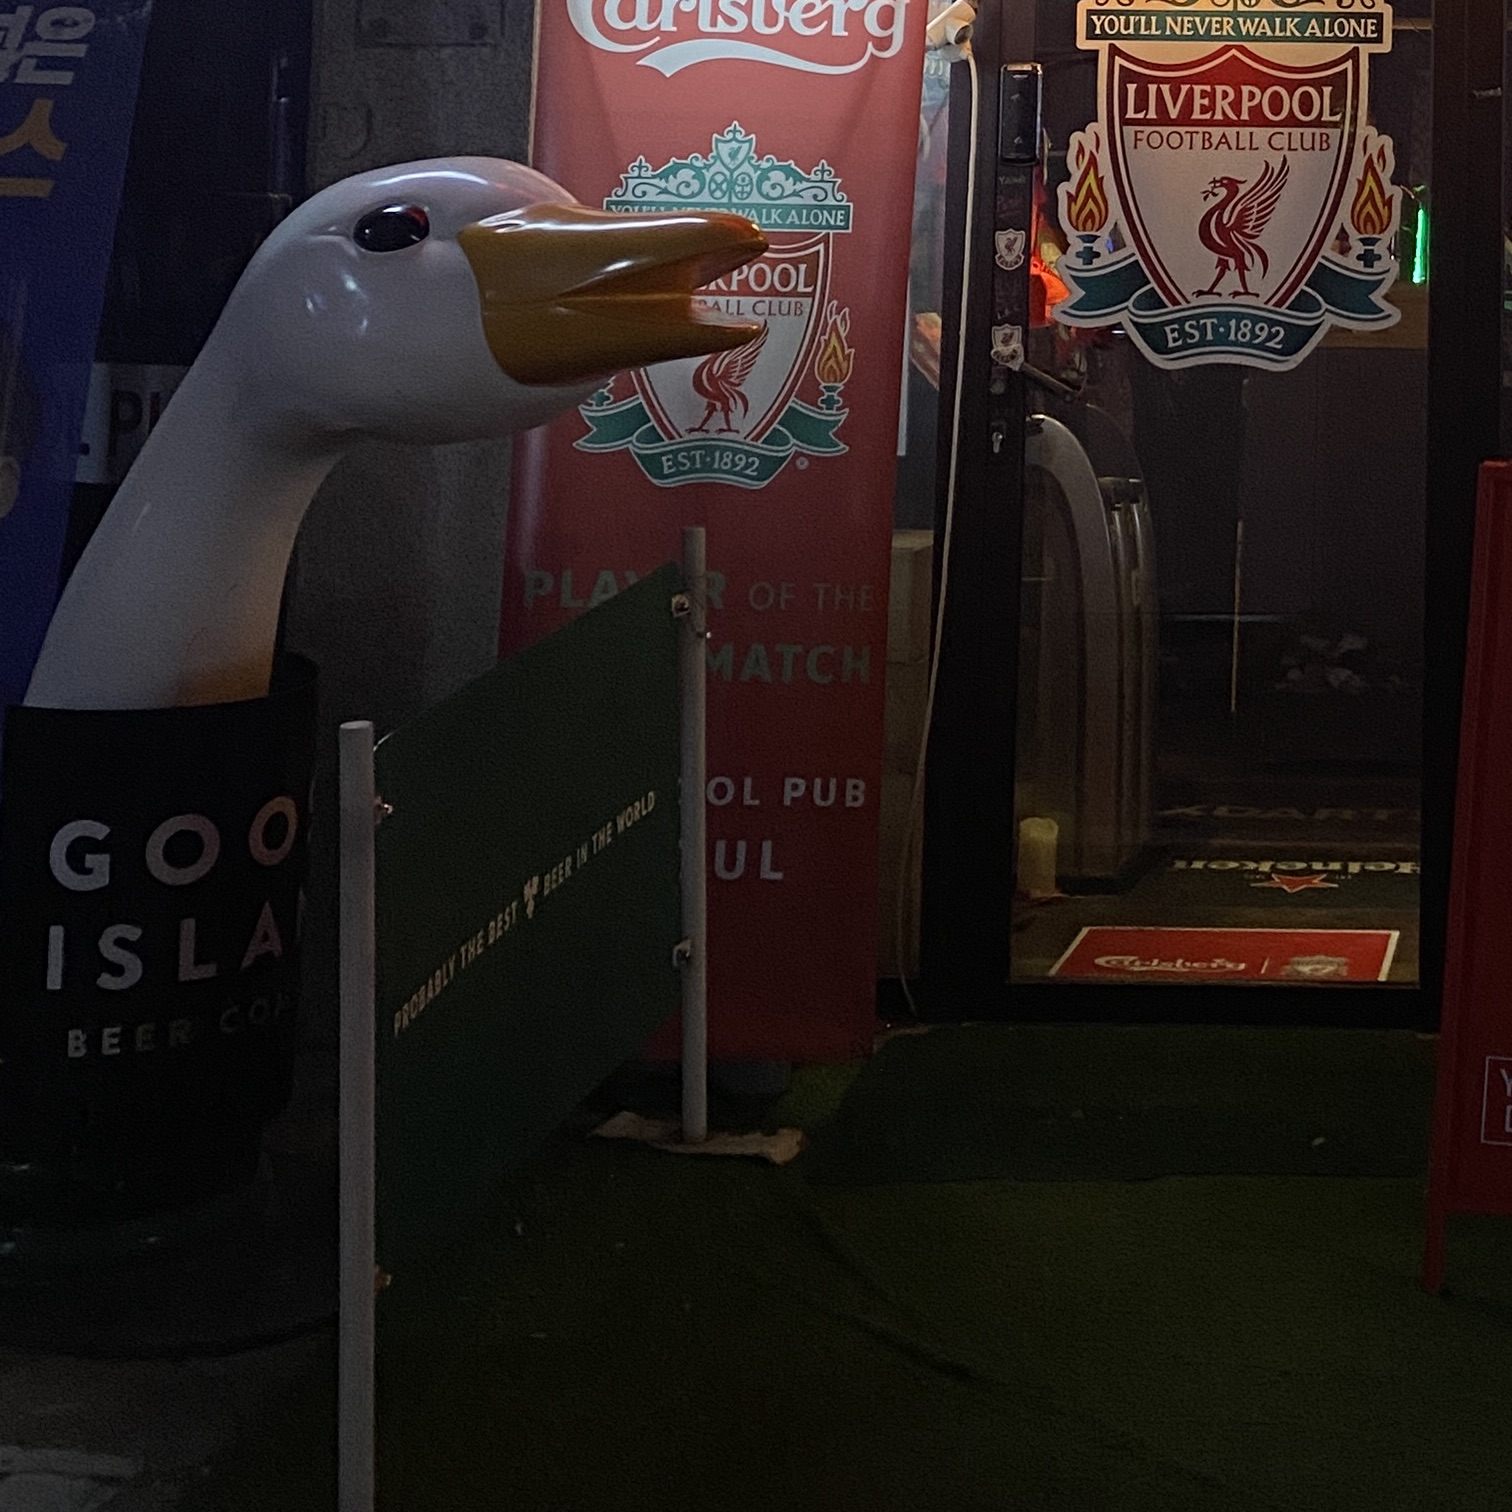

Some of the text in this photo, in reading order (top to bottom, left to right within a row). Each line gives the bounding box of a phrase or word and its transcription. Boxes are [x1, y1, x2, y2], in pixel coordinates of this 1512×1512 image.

[1090, 14, 1379, 39] YOU'LL NEVER WALK ALONE
[1124, 82, 1343, 122] LIVERPOOL
[1133, 130, 1331, 152] FOOTBALL CLUB
[786, 208, 846, 226] ALONE
[752, 299, 804, 317] CLUB
[749, 581, 796, 611] OF
[814, 583, 875, 612] THE
[783, 776, 867, 808] PUB
[393, 791, 656, 1038] PROBABLY THE BEST BEER IN THE WORLD
